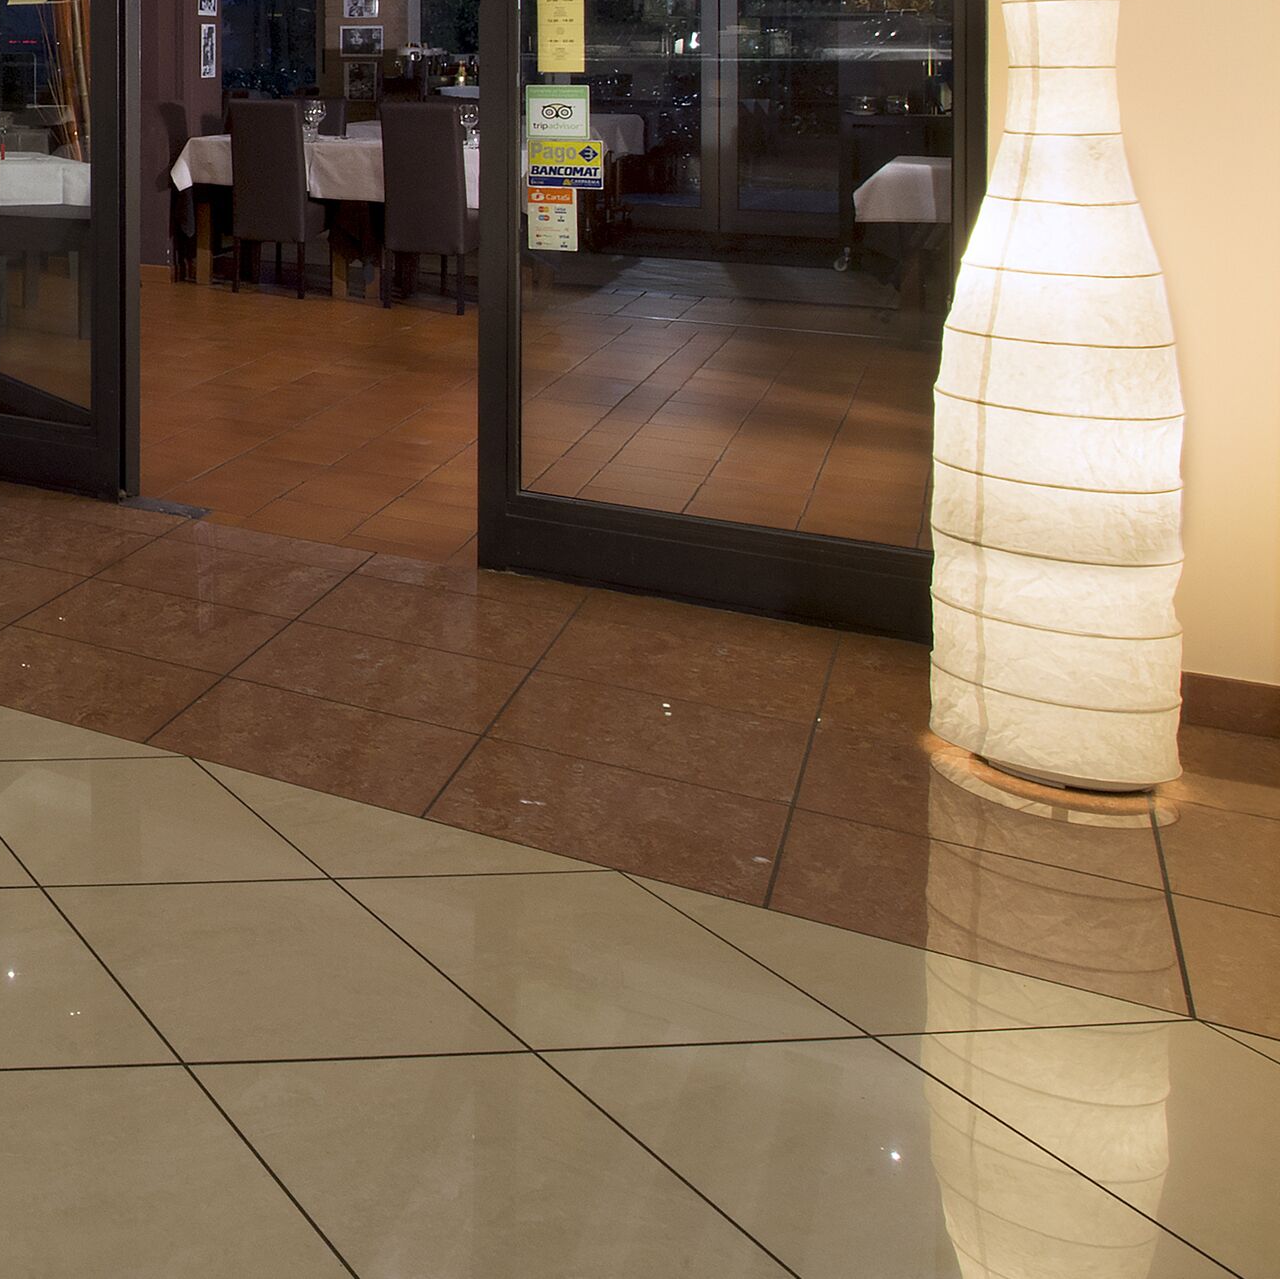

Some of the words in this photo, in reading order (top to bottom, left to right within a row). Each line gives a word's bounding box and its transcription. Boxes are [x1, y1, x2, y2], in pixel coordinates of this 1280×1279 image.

[533, 122, 579, 130] tripadvisor
[531, 142, 576, 162] Pago
[531, 166, 600, 176] BANCOMAT
